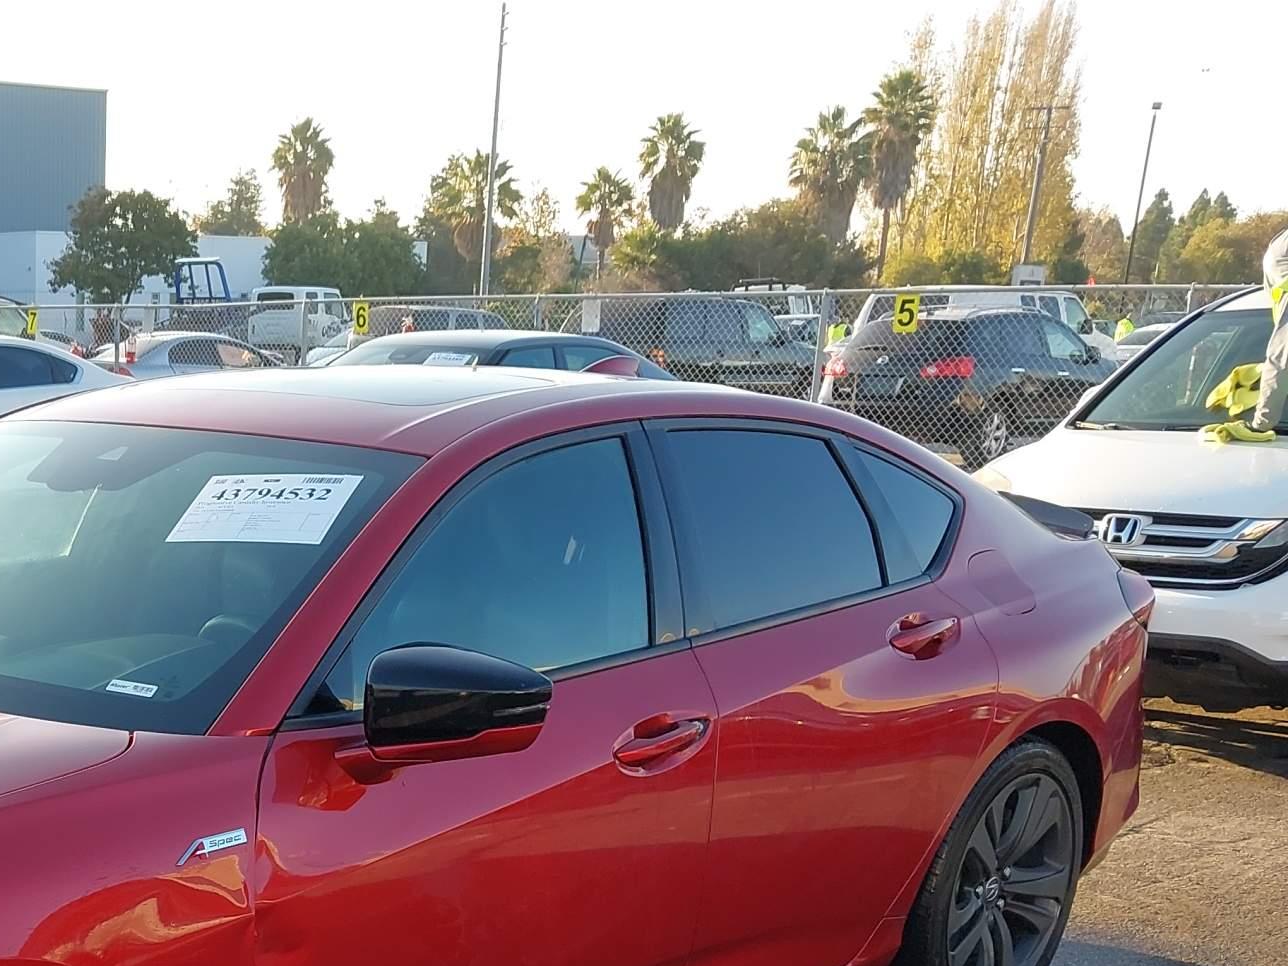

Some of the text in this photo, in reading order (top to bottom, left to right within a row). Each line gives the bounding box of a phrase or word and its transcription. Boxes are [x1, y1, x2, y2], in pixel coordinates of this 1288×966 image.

[30, 311, 37, 330] 7
[356, 306, 367, 328] 6
[897, 299, 915, 327] 5
[211, 488, 332, 501] 43794532
